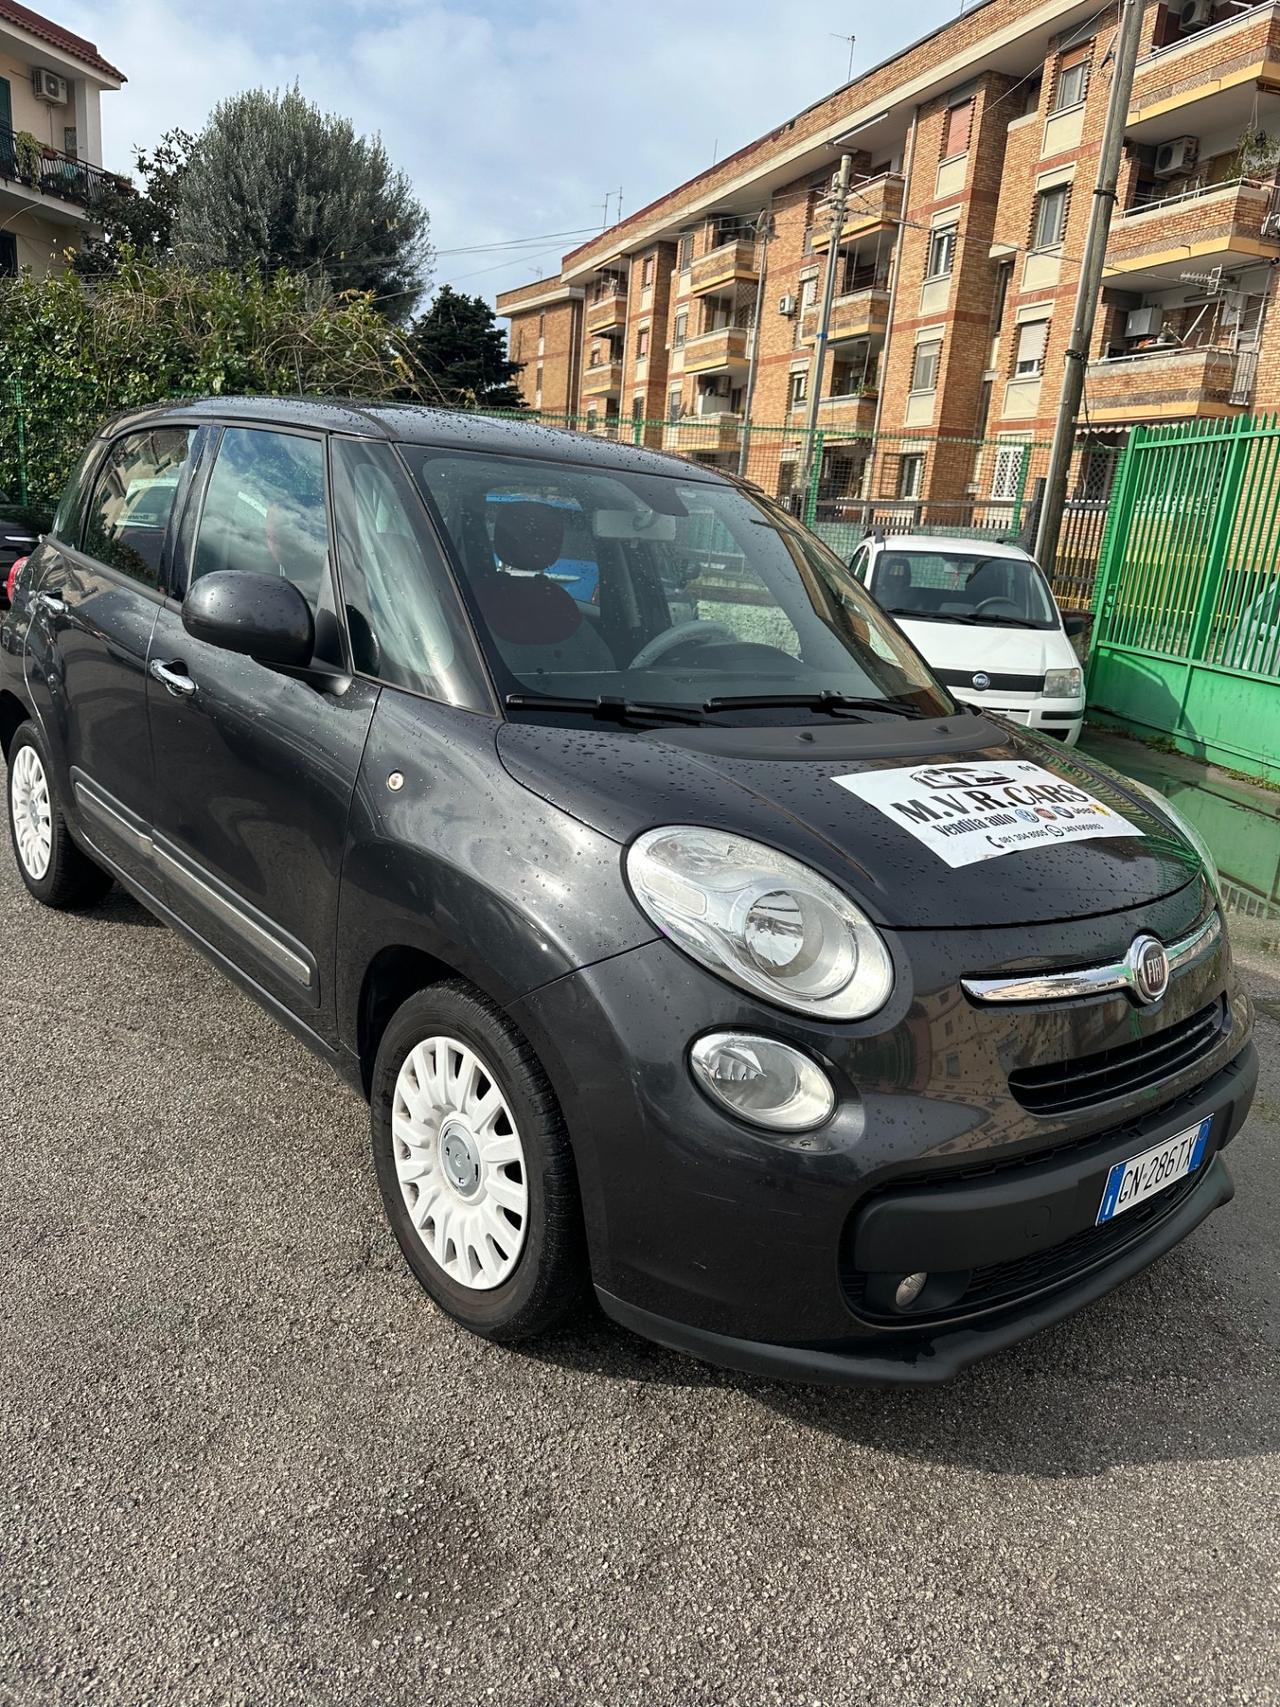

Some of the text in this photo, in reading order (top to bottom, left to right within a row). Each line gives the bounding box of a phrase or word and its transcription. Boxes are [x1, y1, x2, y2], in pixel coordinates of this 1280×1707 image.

[889, 784, 1089, 825] M.V.R.CARS
[931, 818, 991, 837] Vendita
[984, 813, 1018, 827] auto
[1146, 956, 1164, 984] FIAT
